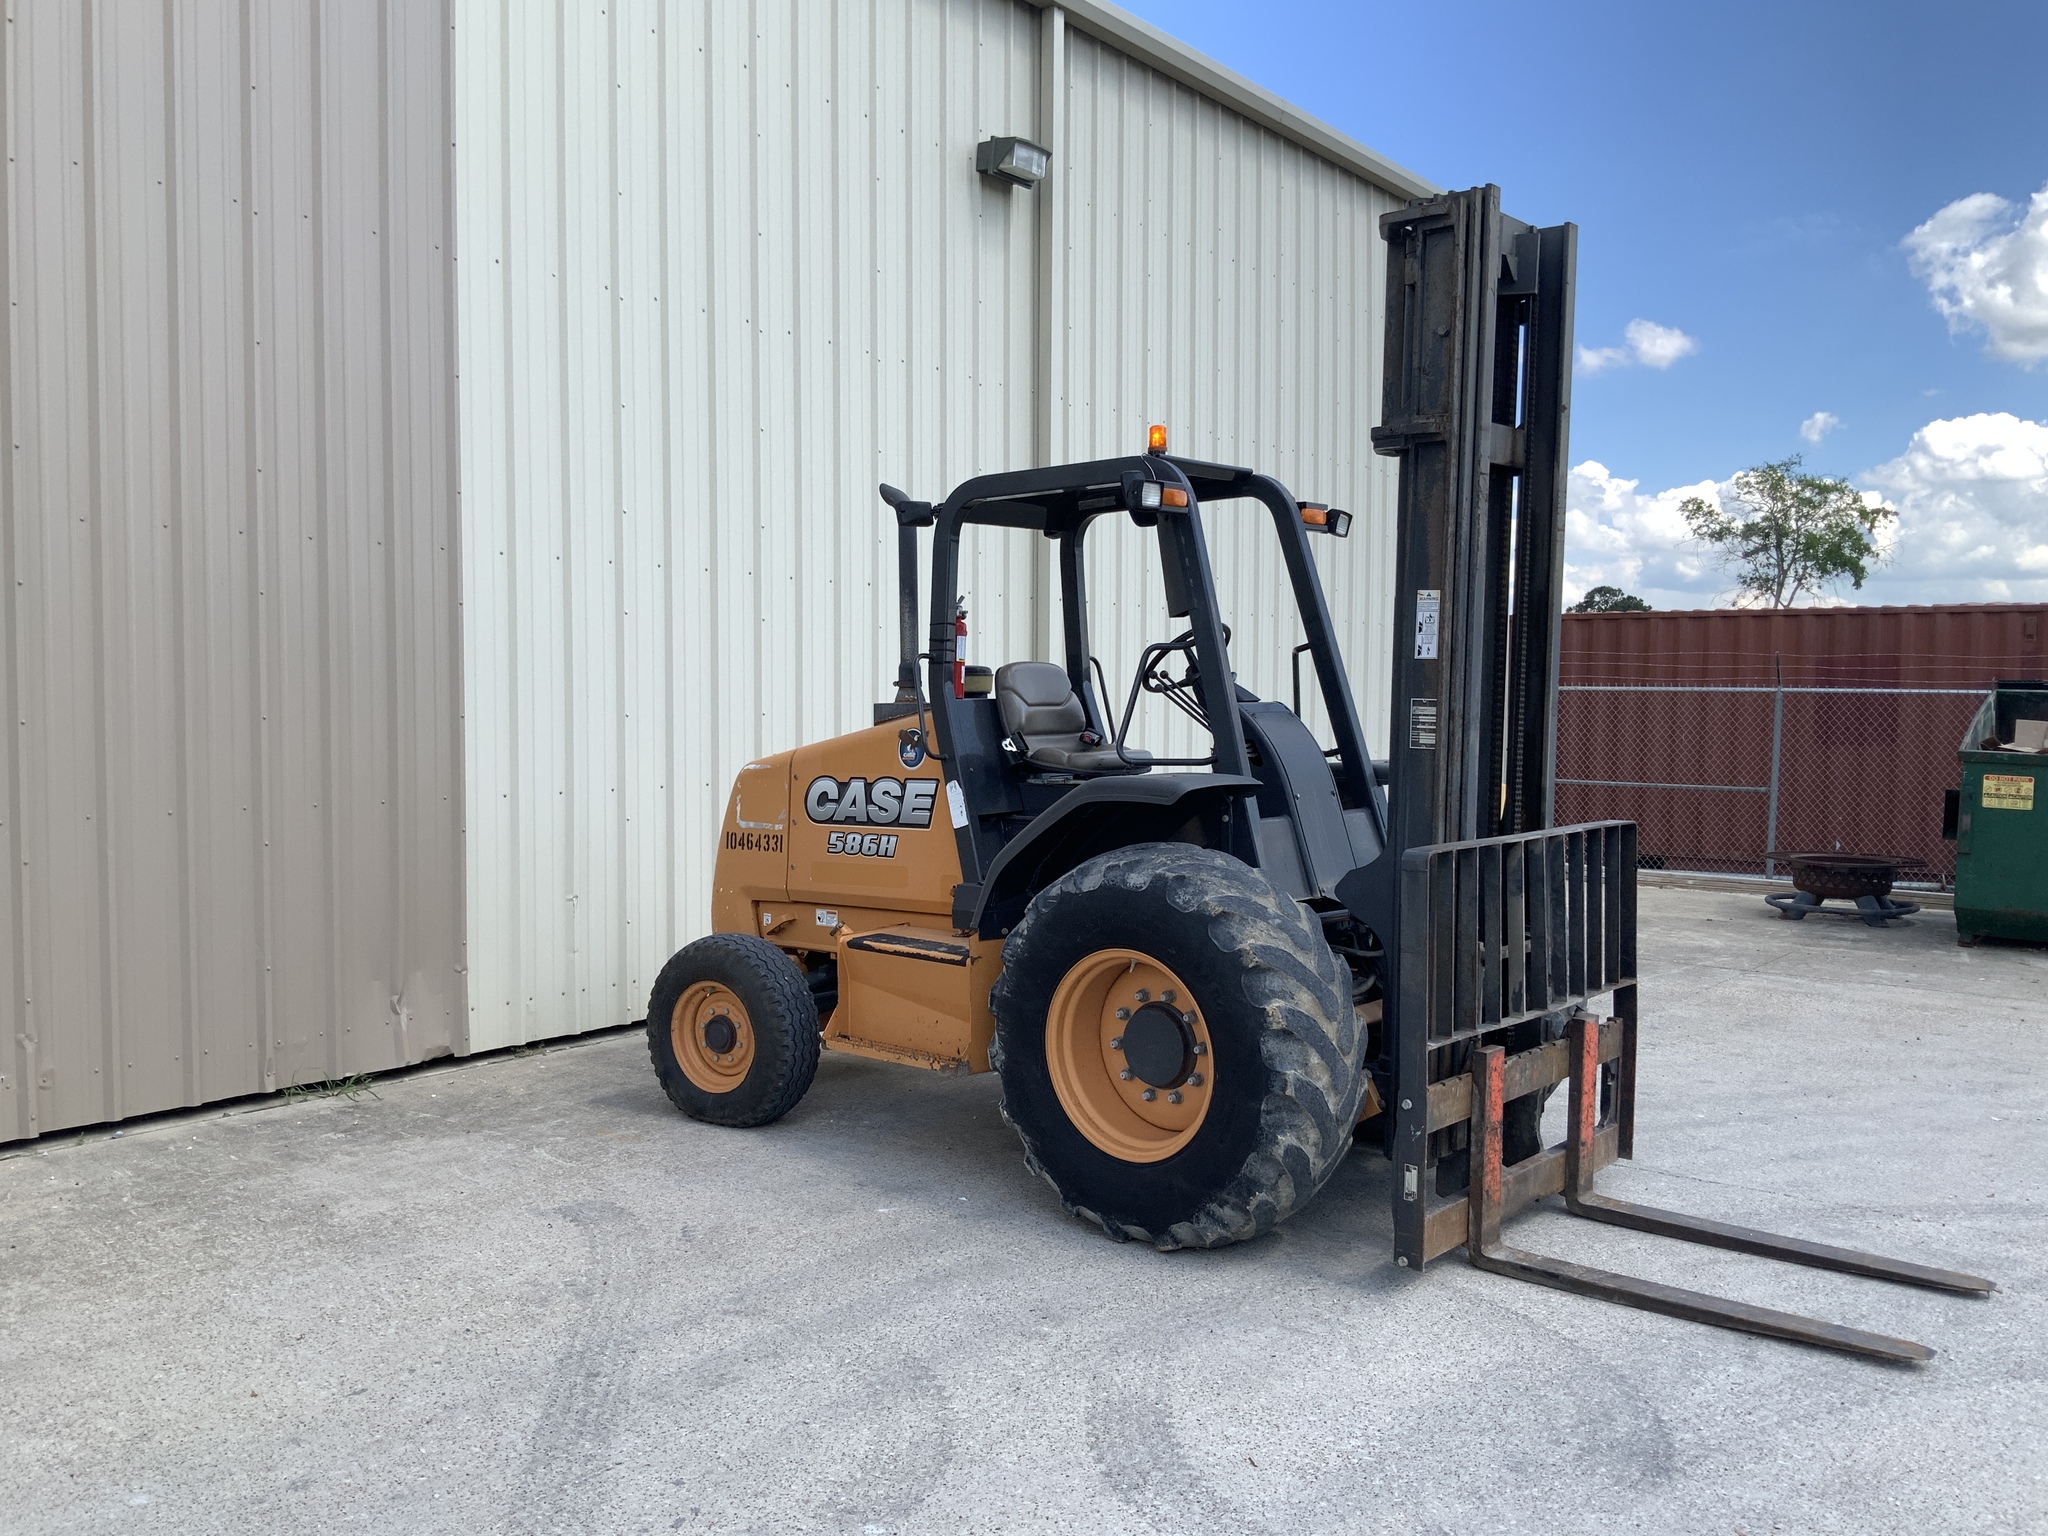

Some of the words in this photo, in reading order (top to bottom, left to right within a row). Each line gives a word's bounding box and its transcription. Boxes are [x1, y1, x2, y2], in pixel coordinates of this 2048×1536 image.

[806, 776, 938, 825] CASE
[726, 831, 783, 853] 10464331
[827, 831, 898, 858] 586H
